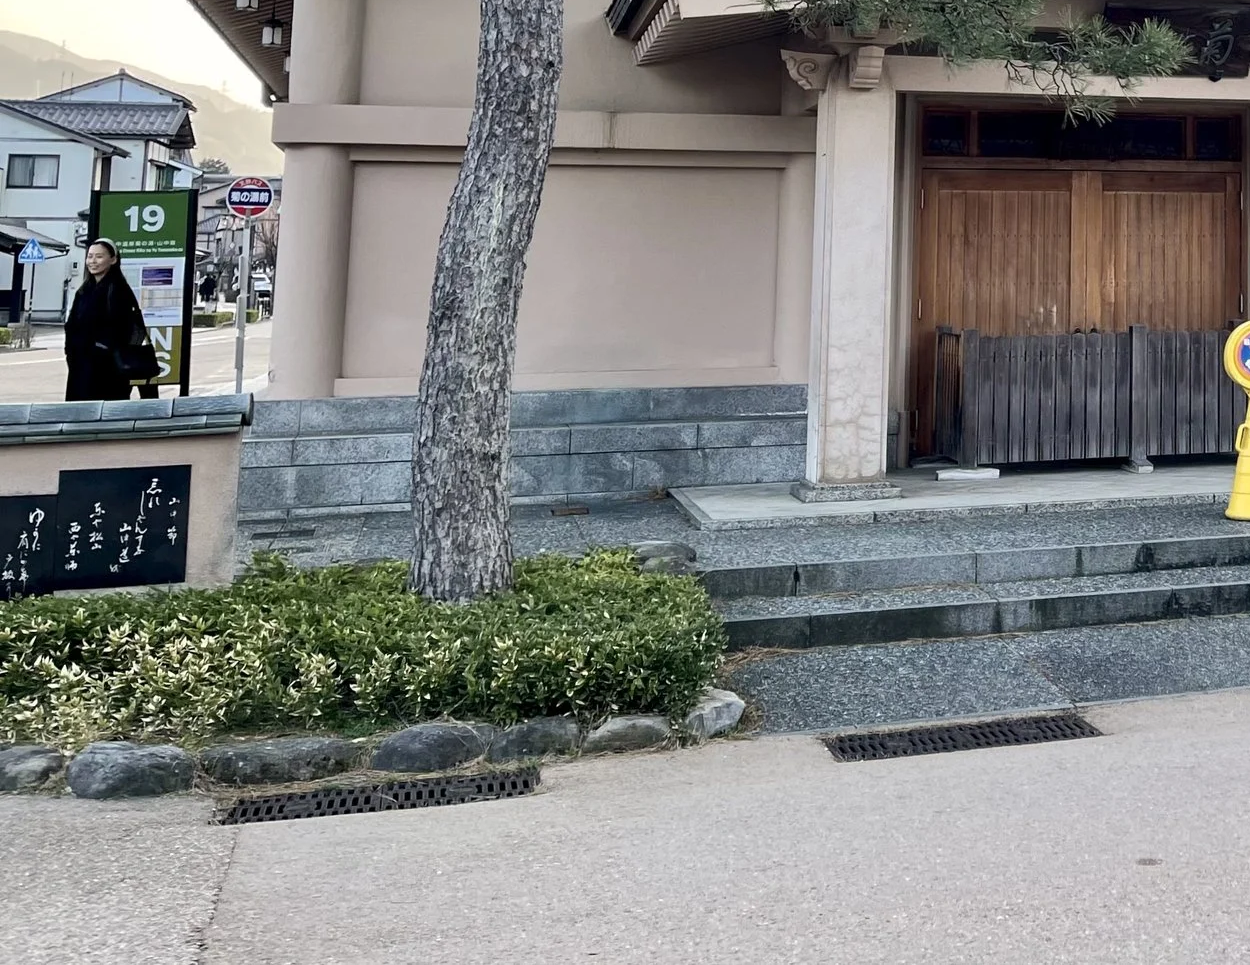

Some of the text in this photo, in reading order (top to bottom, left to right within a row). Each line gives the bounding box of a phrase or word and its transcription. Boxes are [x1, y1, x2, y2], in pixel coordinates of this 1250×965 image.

[230, 191, 270, 203] 菊の湯前
[124, 204, 165, 232] 19
